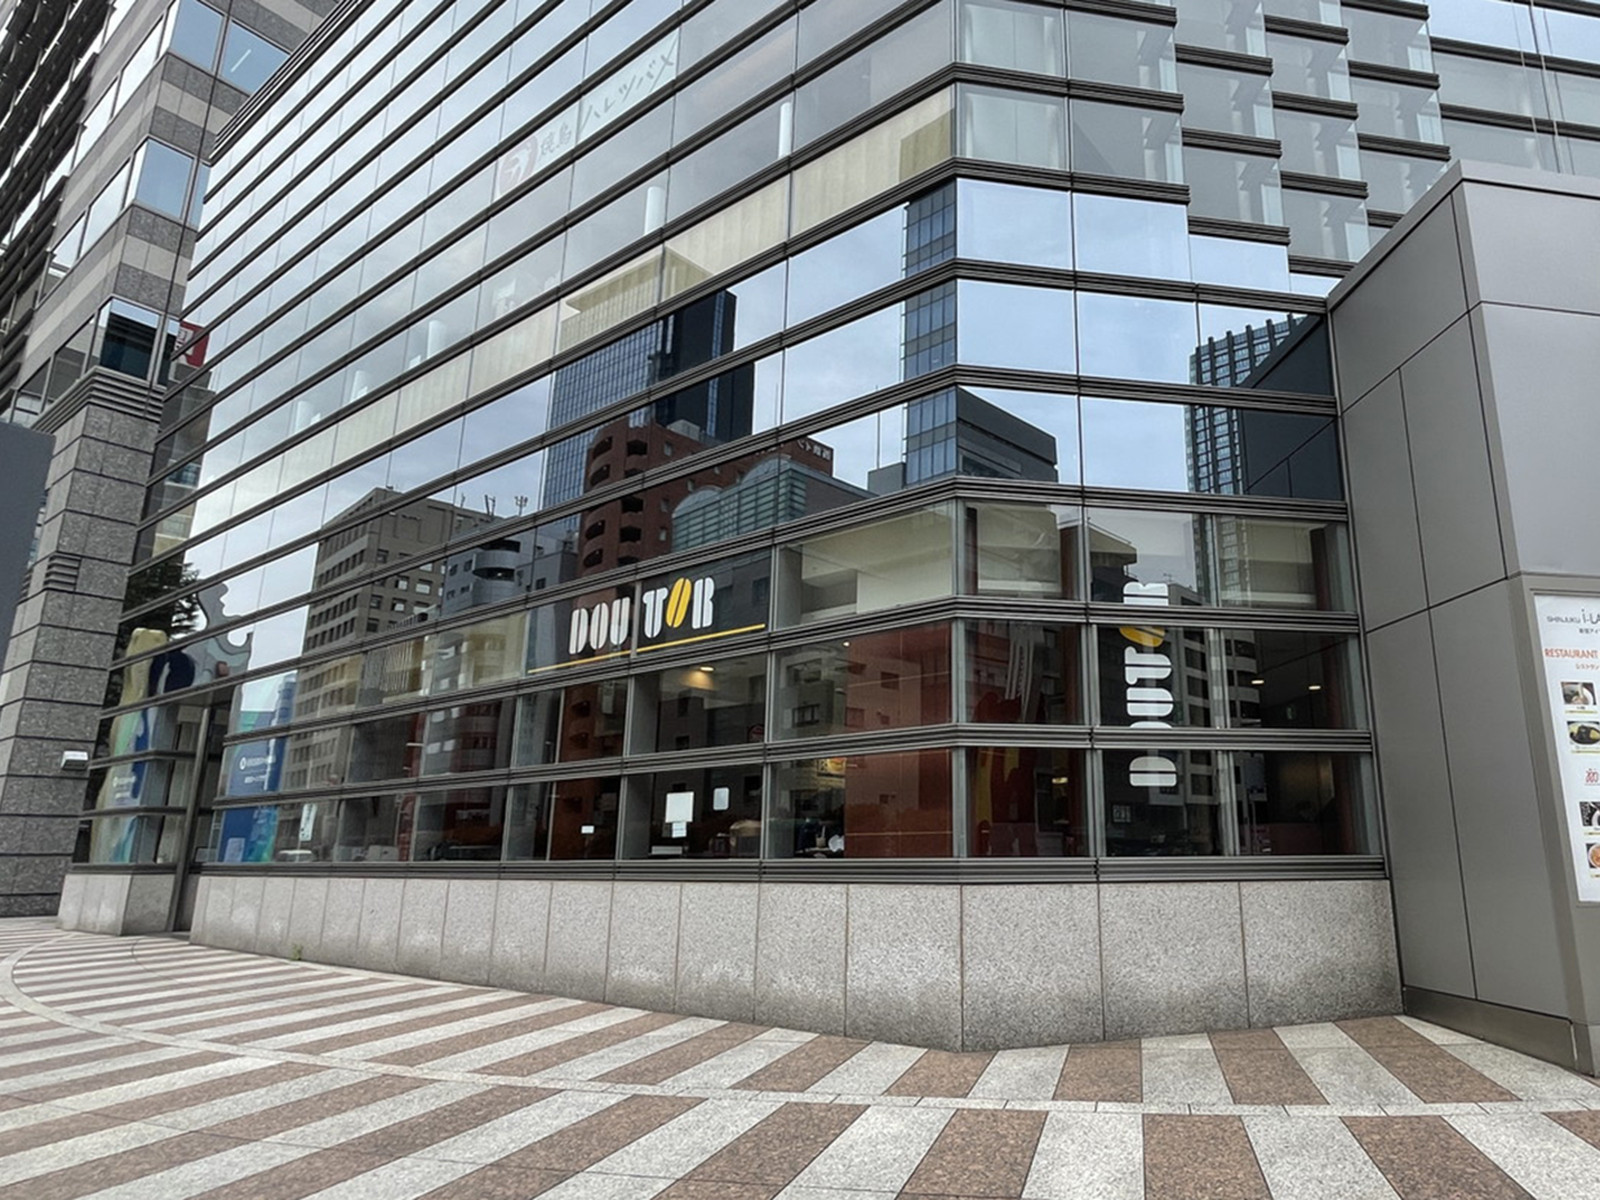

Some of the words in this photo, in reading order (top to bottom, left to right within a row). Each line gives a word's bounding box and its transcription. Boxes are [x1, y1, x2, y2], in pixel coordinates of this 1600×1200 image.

[569, 577, 715, 655] DOUTOR
[1544, 648, 1598, 659] RESTAURANT
[1119, 582, 1177, 787] DUTOR
